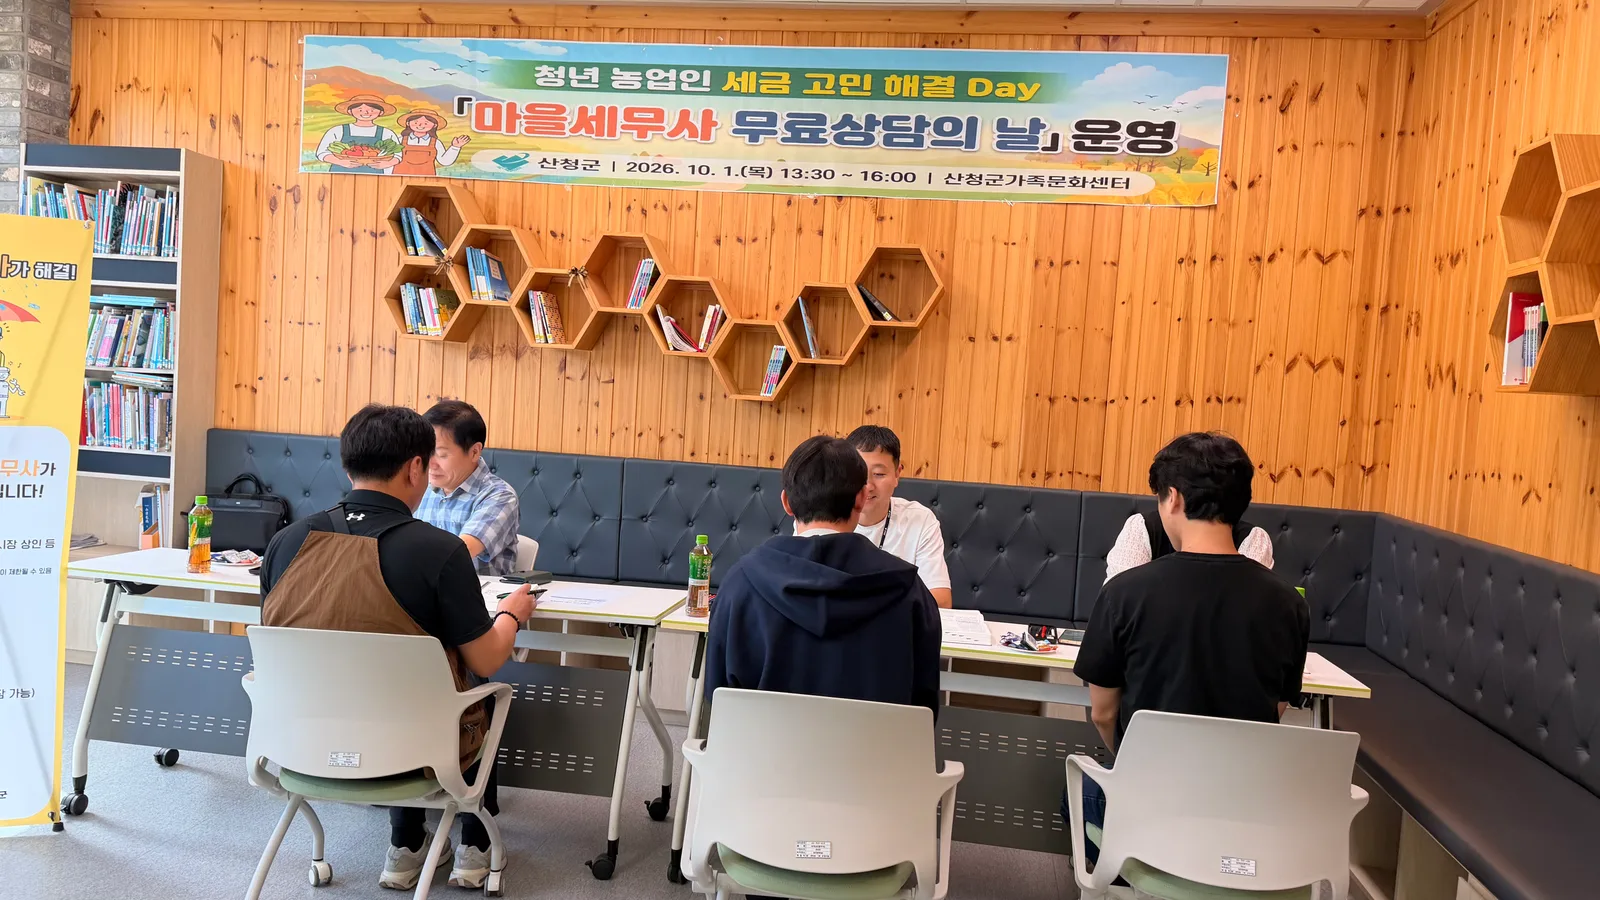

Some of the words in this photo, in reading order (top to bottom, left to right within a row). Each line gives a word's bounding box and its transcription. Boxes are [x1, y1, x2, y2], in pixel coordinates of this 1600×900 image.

[534, 64, 600, 89] 청년
[611, 67, 712, 92] 농업인
[721, 71, 792, 95] 세금
[802, 73, 872, 96] 고민
[884, 75, 955, 98] 해결
[967, 77, 1041, 101] Day
[731, 110, 979, 149] 무료상담의
[1071, 118, 1177, 154] 운영
[538, 156, 601, 172] 산청군
[626, 161, 680, 175] 2026.
[687, 164, 716, 176] 10.
[723, 166, 773, 179] 1.(목)
[780, 168, 836, 181] 13:30
[860, 170, 917, 183] 16:00
[943, 173, 1131, 190] 산청군가족문화센터
[34, 262, 77, 280] 해결!
[21, 539, 42, 550] 상인
[45, 538, 56, 549] 등
[9, 687, 36, 699] 가능)
